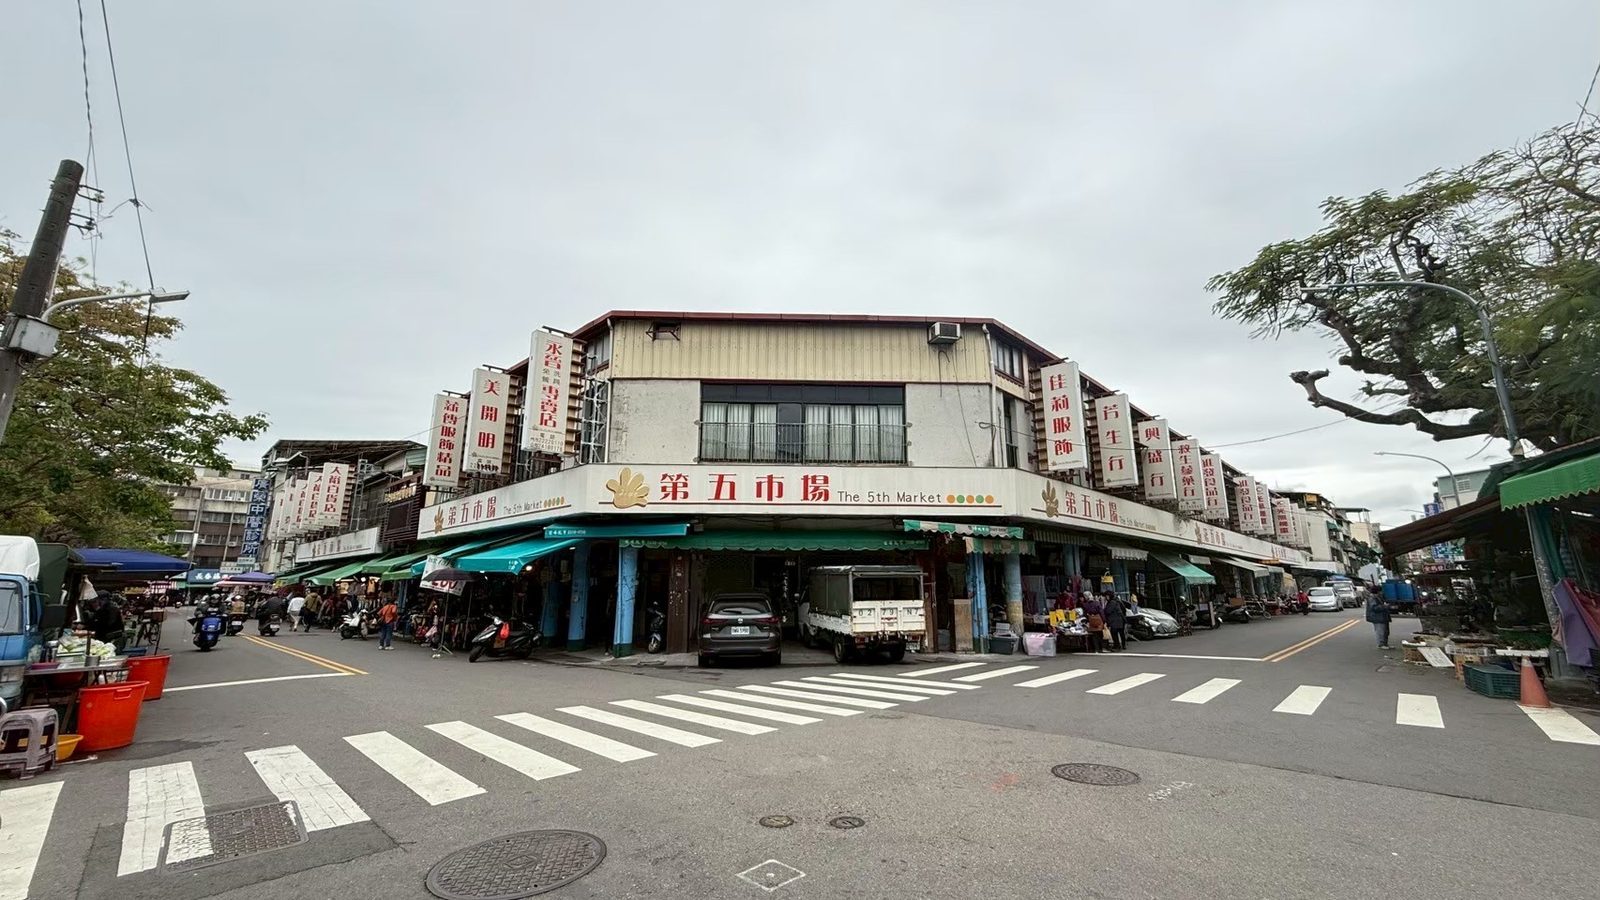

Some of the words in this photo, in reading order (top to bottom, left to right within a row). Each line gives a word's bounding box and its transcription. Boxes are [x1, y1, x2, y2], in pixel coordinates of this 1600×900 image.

[477, 378, 501, 449] 美開明
[1049, 373, 1074, 456] 佳莉服飾
[659, 472, 830, 502] 第五市場
[836, 490, 860, 503] The
[867, 491, 891, 503] 5th
[896, 491, 942, 503] Market
[447, 495, 497, 526] 第五市場
[1065, 489, 1119, 523] 第五市場
